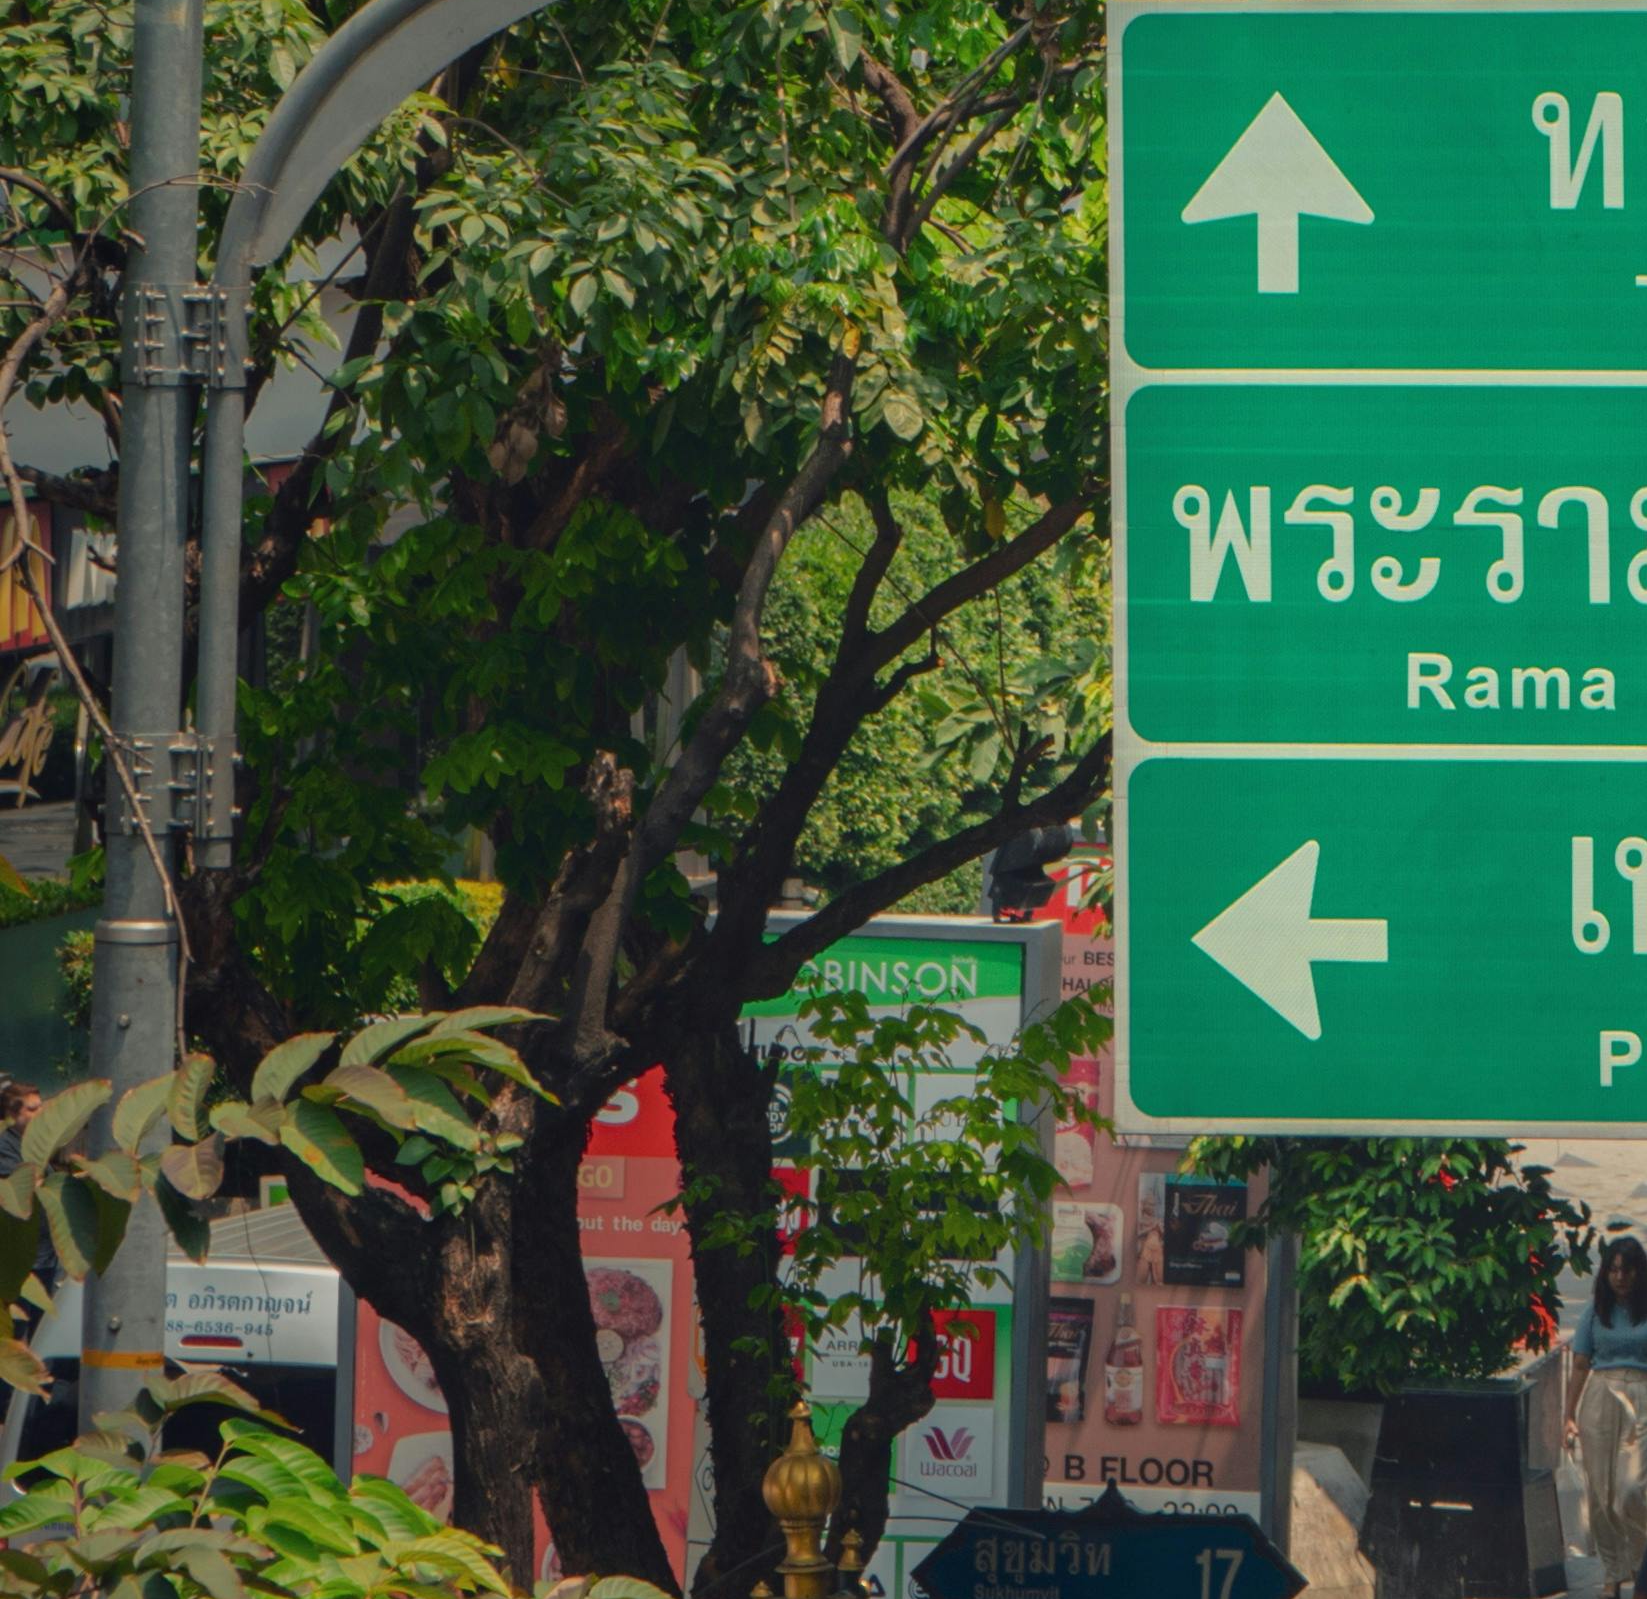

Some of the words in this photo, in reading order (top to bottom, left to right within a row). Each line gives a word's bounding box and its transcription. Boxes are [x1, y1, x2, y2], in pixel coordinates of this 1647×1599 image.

[1407, 653, 1615, 710] Rama
[793, 960, 977, 996] OBINSON
[613, 1216, 643, 1231] the
[920, 1462, 977, 1477] Wacoal
[1064, 1454, 1086, 1480] B
[1100, 1456, 1215, 1488] FLOOR
[974, 1529, 1112, 1584] สุขุมวิท
